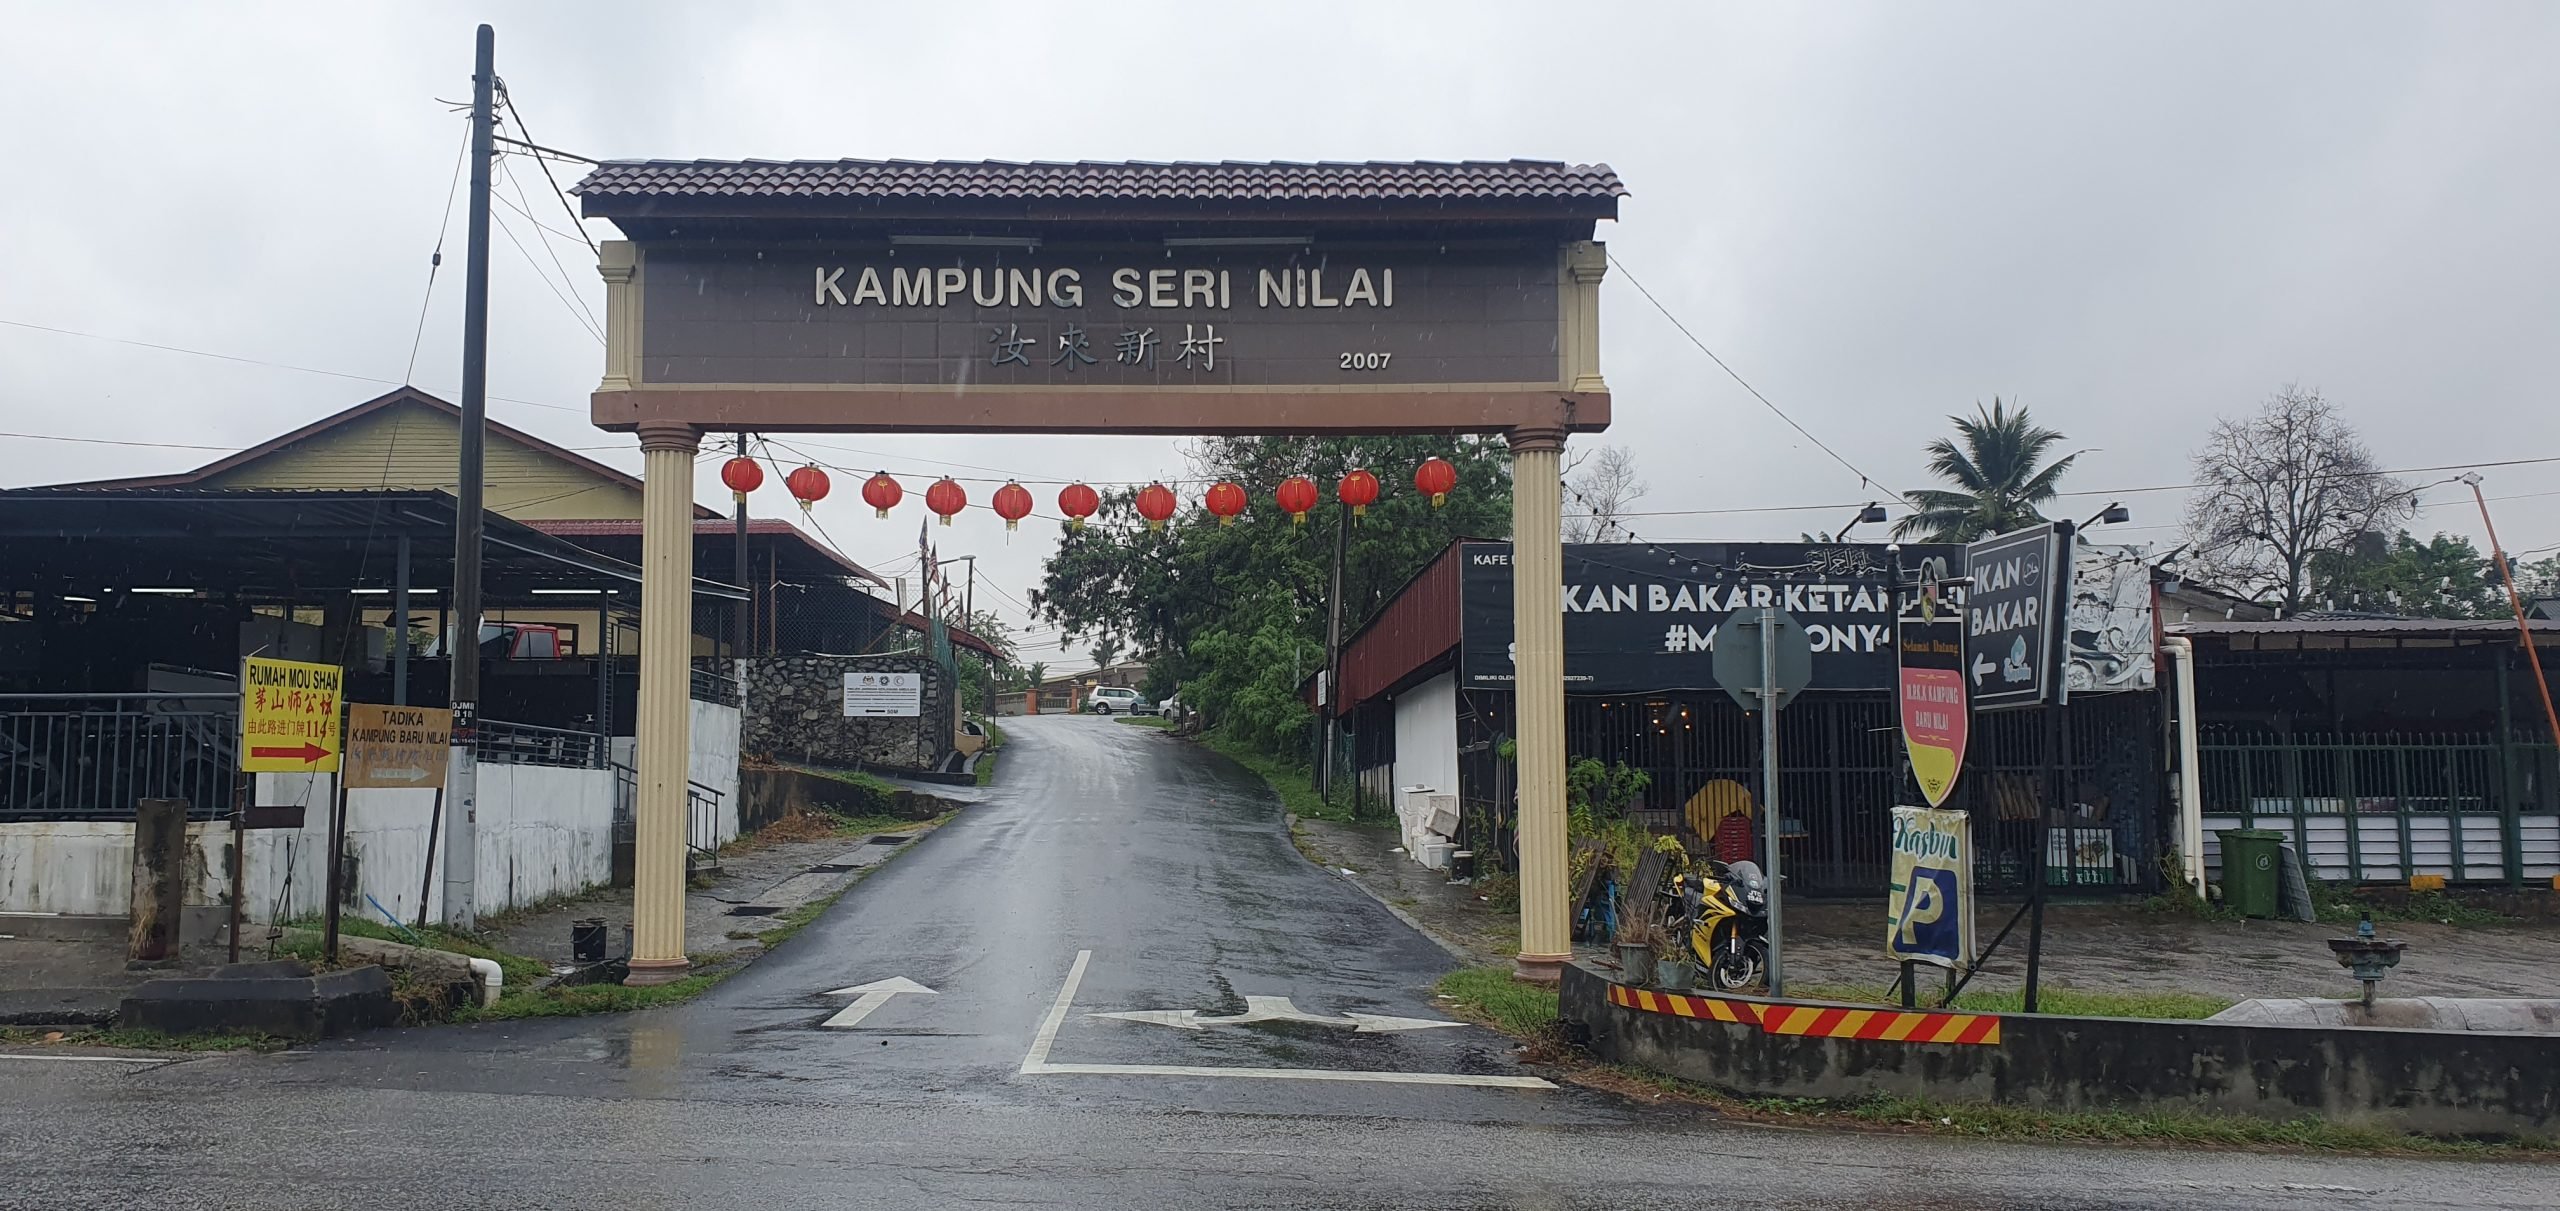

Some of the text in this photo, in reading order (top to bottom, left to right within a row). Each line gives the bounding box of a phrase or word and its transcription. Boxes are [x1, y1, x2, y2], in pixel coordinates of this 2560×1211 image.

[815, 267, 1394, 309] KAMPUNG SERI NILAI
[989, 322, 1223, 370] 汝來新村
[1340, 352, 1392, 370] 2007
[1474, 555, 1508, 565] KAFE
[1973, 557, 2021, 595] IKAN
[1648, 584, 1773, 612] BAKAR
[1971, 596, 2038, 637] BAKAR
[1933, 639, 1959, 656] Datang
[249, 665, 338, 691] RUMAH MOU SHAN
[1928, 685, 1959, 705] KAMPUNG
[382, 710, 424, 726] TADIKA
[1915, 710, 1931, 728] BARU
[352, 728, 448, 745] KAMPUNG BARU NILAI
[1902, 876, 1944, 945] P
